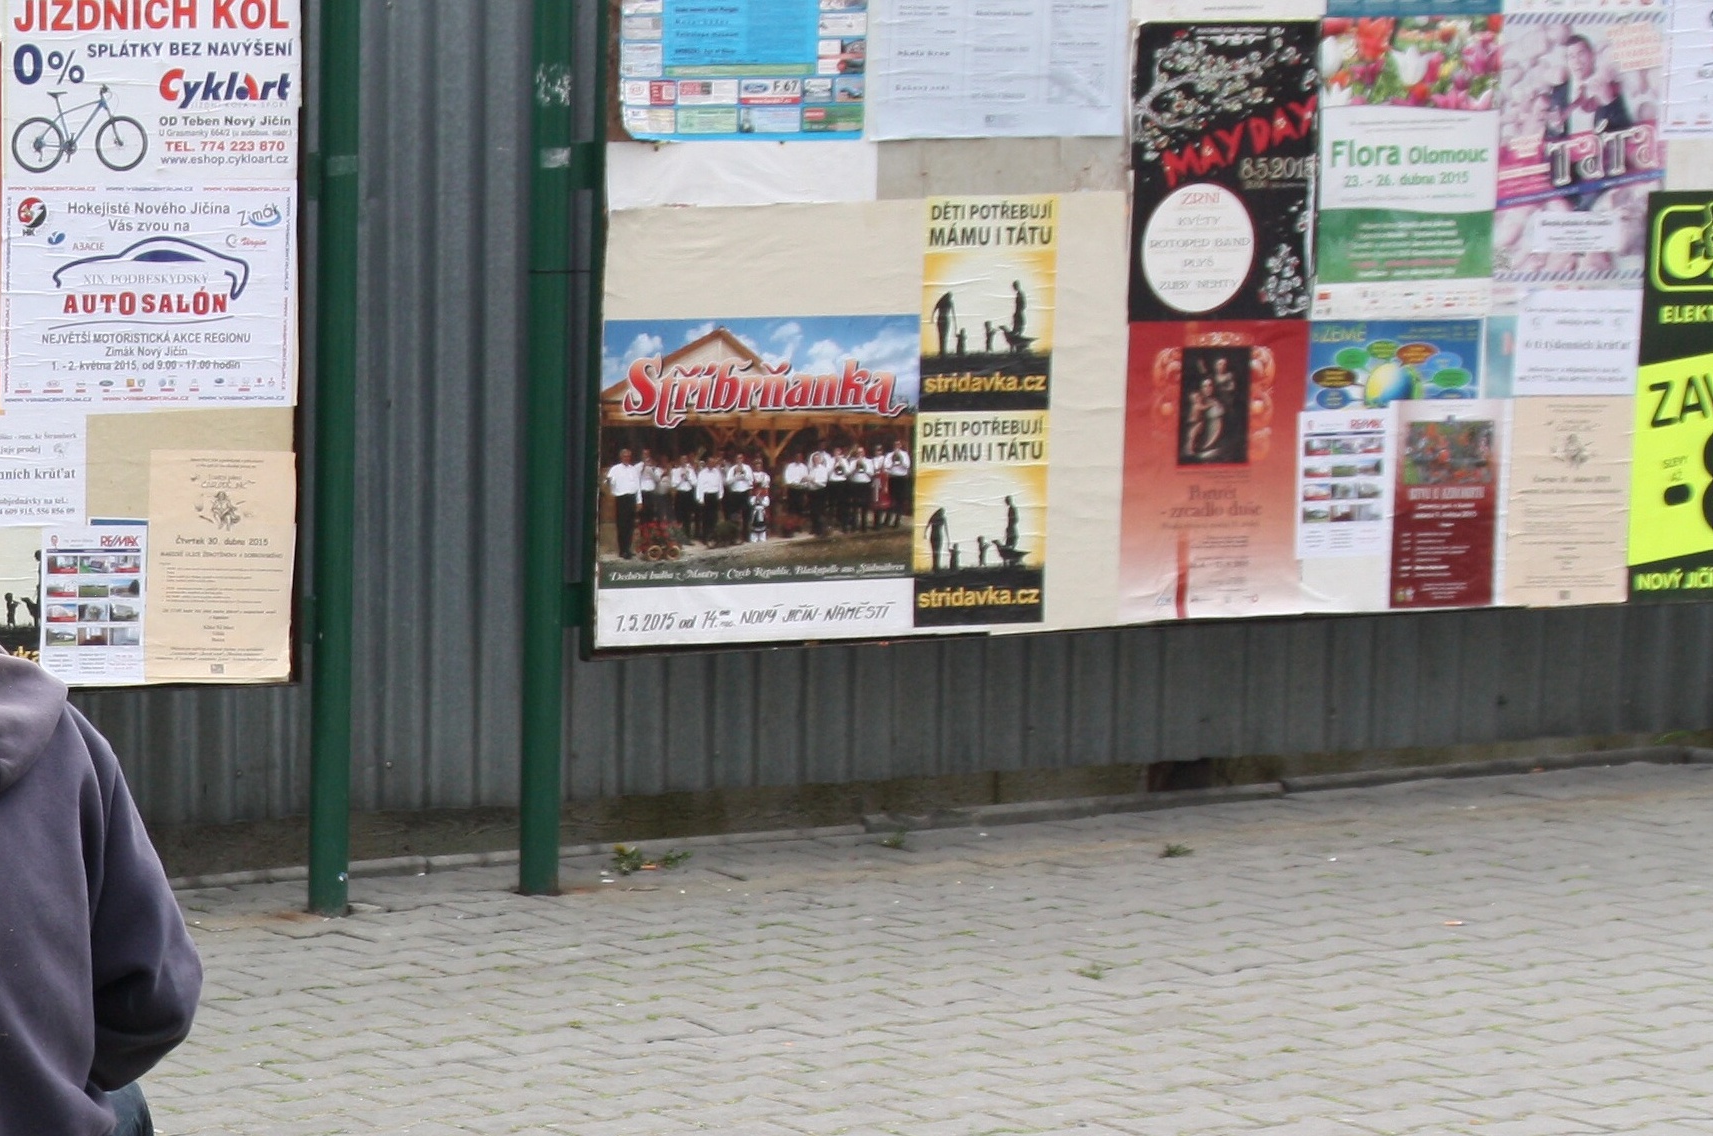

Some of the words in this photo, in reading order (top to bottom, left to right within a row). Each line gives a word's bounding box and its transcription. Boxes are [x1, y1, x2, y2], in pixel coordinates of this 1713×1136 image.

[213, 0, 290, 31] KOL
[87, 39, 163, 58] SPLÁTKY
[169, 43, 201, 57] BEZ
[208, 38, 293, 57] NAVÝŠENÍ
[159, 117, 177, 127] OD
[183, 116, 220, 127] Teben
[224, 115, 256, 129] Nový
[260, 115, 291, 127] Jičín
[165, 141, 195, 152] TEL.
[200, 141, 224, 152] 774
[230, 141, 254, 152] 223
[260, 141, 285, 151] 870
[1162, 95, 1318, 188] MAYDAY
[161, 154, 289, 166] www.eshop.cykloart.cz
[1331, 139, 1402, 168] Flora
[1408, 145, 1490, 165] Olomouc
[1400, 173, 1435, 186] dubna
[1439, 170, 1470, 184] 2015
[67, 202, 131, 216] Hokejisté
[134, 202, 187, 215] Nového
[191, 201, 231, 215] Jičína
[237, 201, 280, 226] Zimák
[931, 201, 966, 220] DĚTI
[970, 200, 1054, 220] POTŘEBUJÍ
[108, 219, 133, 232] Vás
[137, 222, 169, 232] zvou
[173, 222, 190, 232] na
[929, 222, 992, 246] MÁMU
[1006, 222, 1053, 245] TÁTU
[1215, 237, 1251, 247] BAND
[111, 272, 210, 285] PODBESKYDSKÝ
[63, 287, 229, 315] AUTOSALÓN
[42, 331, 91, 344] NEJVĚTŠÍ
[93, 331, 170, 343] MOTORISTICKÁ
[173, 332, 201, 343] AKCE
[204, 332, 251, 343] REGIONU
[105, 346, 135, 357] Zimák
[137, 346, 162, 358] Nový
[165, 345, 188, 357] Jičín
[79, 360, 111, 371] května
[114, 360, 139, 372] 2015,
[142, 360, 155, 370] od
[157, 360, 177, 370] 9.00
[213, 360, 241, 370] hodin
[622, 352, 911, 429] Stříbrňanka
[923, 371, 1047, 394] stridavka.cz
[923, 418, 957, 438] DĚTI
[961, 416, 1045, 436] POTŘEBUJÍ
[921, 440, 982, 463] MÁMU
[997, 437, 1044, 461] TÁTU
[100, 535, 139, 548] RE/MAX
[249, 538, 269, 546] 2015
[1636, 567, 1684, 591] NOVÝ
[1686, 565, 1713, 589] JIČÍ
[918, 584, 1041, 609] stridavka.cz
